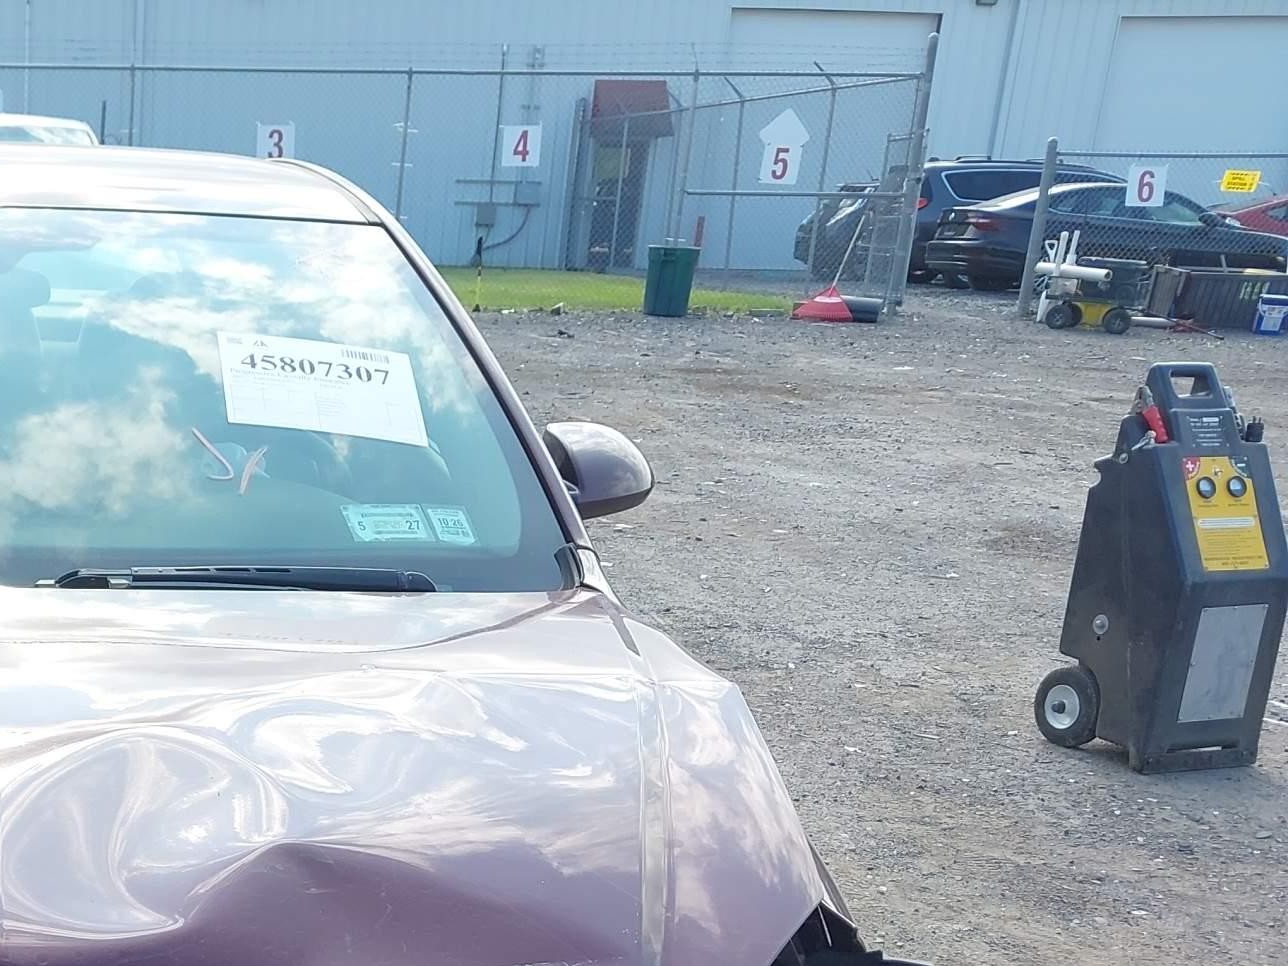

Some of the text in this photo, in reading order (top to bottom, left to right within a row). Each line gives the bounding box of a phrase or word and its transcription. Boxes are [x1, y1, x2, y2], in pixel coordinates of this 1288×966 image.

[268, 129, 283, 158] 3
[513, 130, 529, 162] 4
[772, 147, 790, 180] 5
[1137, 169, 1156, 203] 6
[240, 352, 390, 386] 45807307
[357, 520, 367, 531] 5
[405, 519, 420, 531] 27
